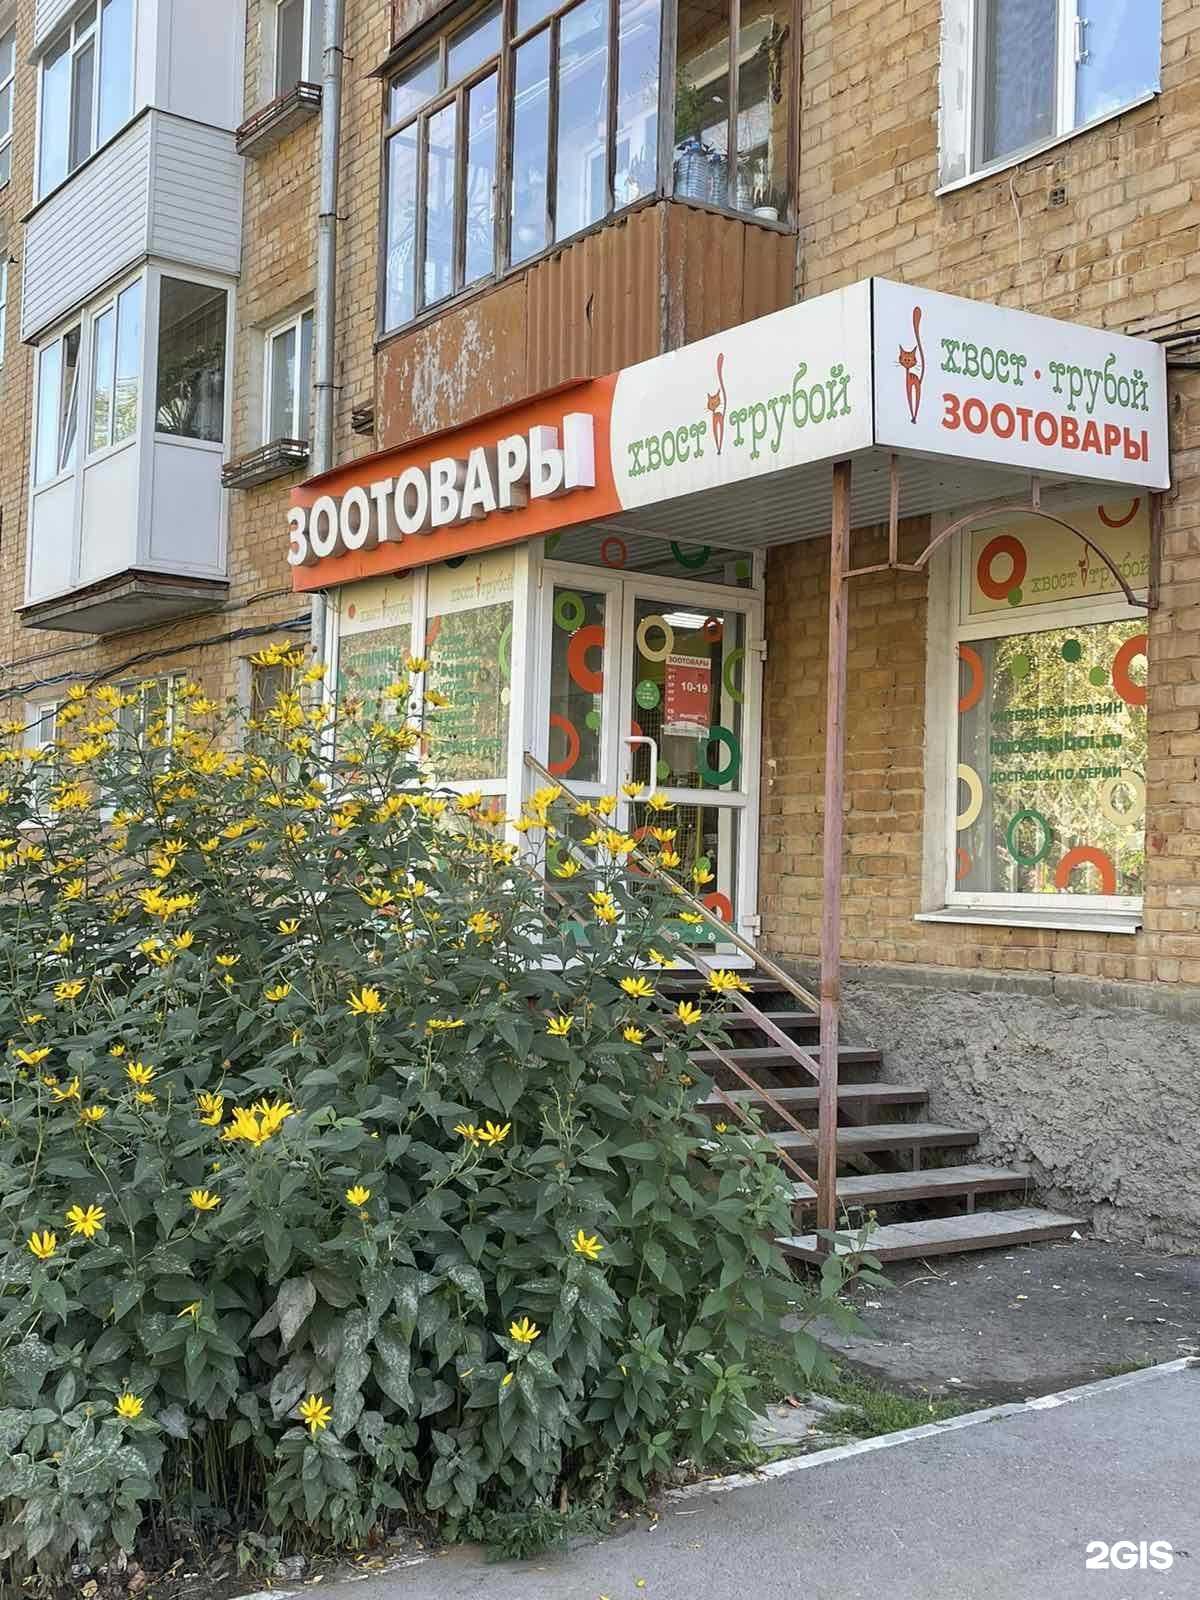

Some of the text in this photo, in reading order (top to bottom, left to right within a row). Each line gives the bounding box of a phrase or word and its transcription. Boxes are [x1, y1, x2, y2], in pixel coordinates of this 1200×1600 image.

[940, 338, 1150, 415] хвост трубой
[626, 361, 852, 478] хвост трубой
[941, 392, 1149, 463] ЗООТОВАРЫ
[287, 411, 596, 567] ЗООТОВАРЫ
[681, 680, 708, 693] 10-19
